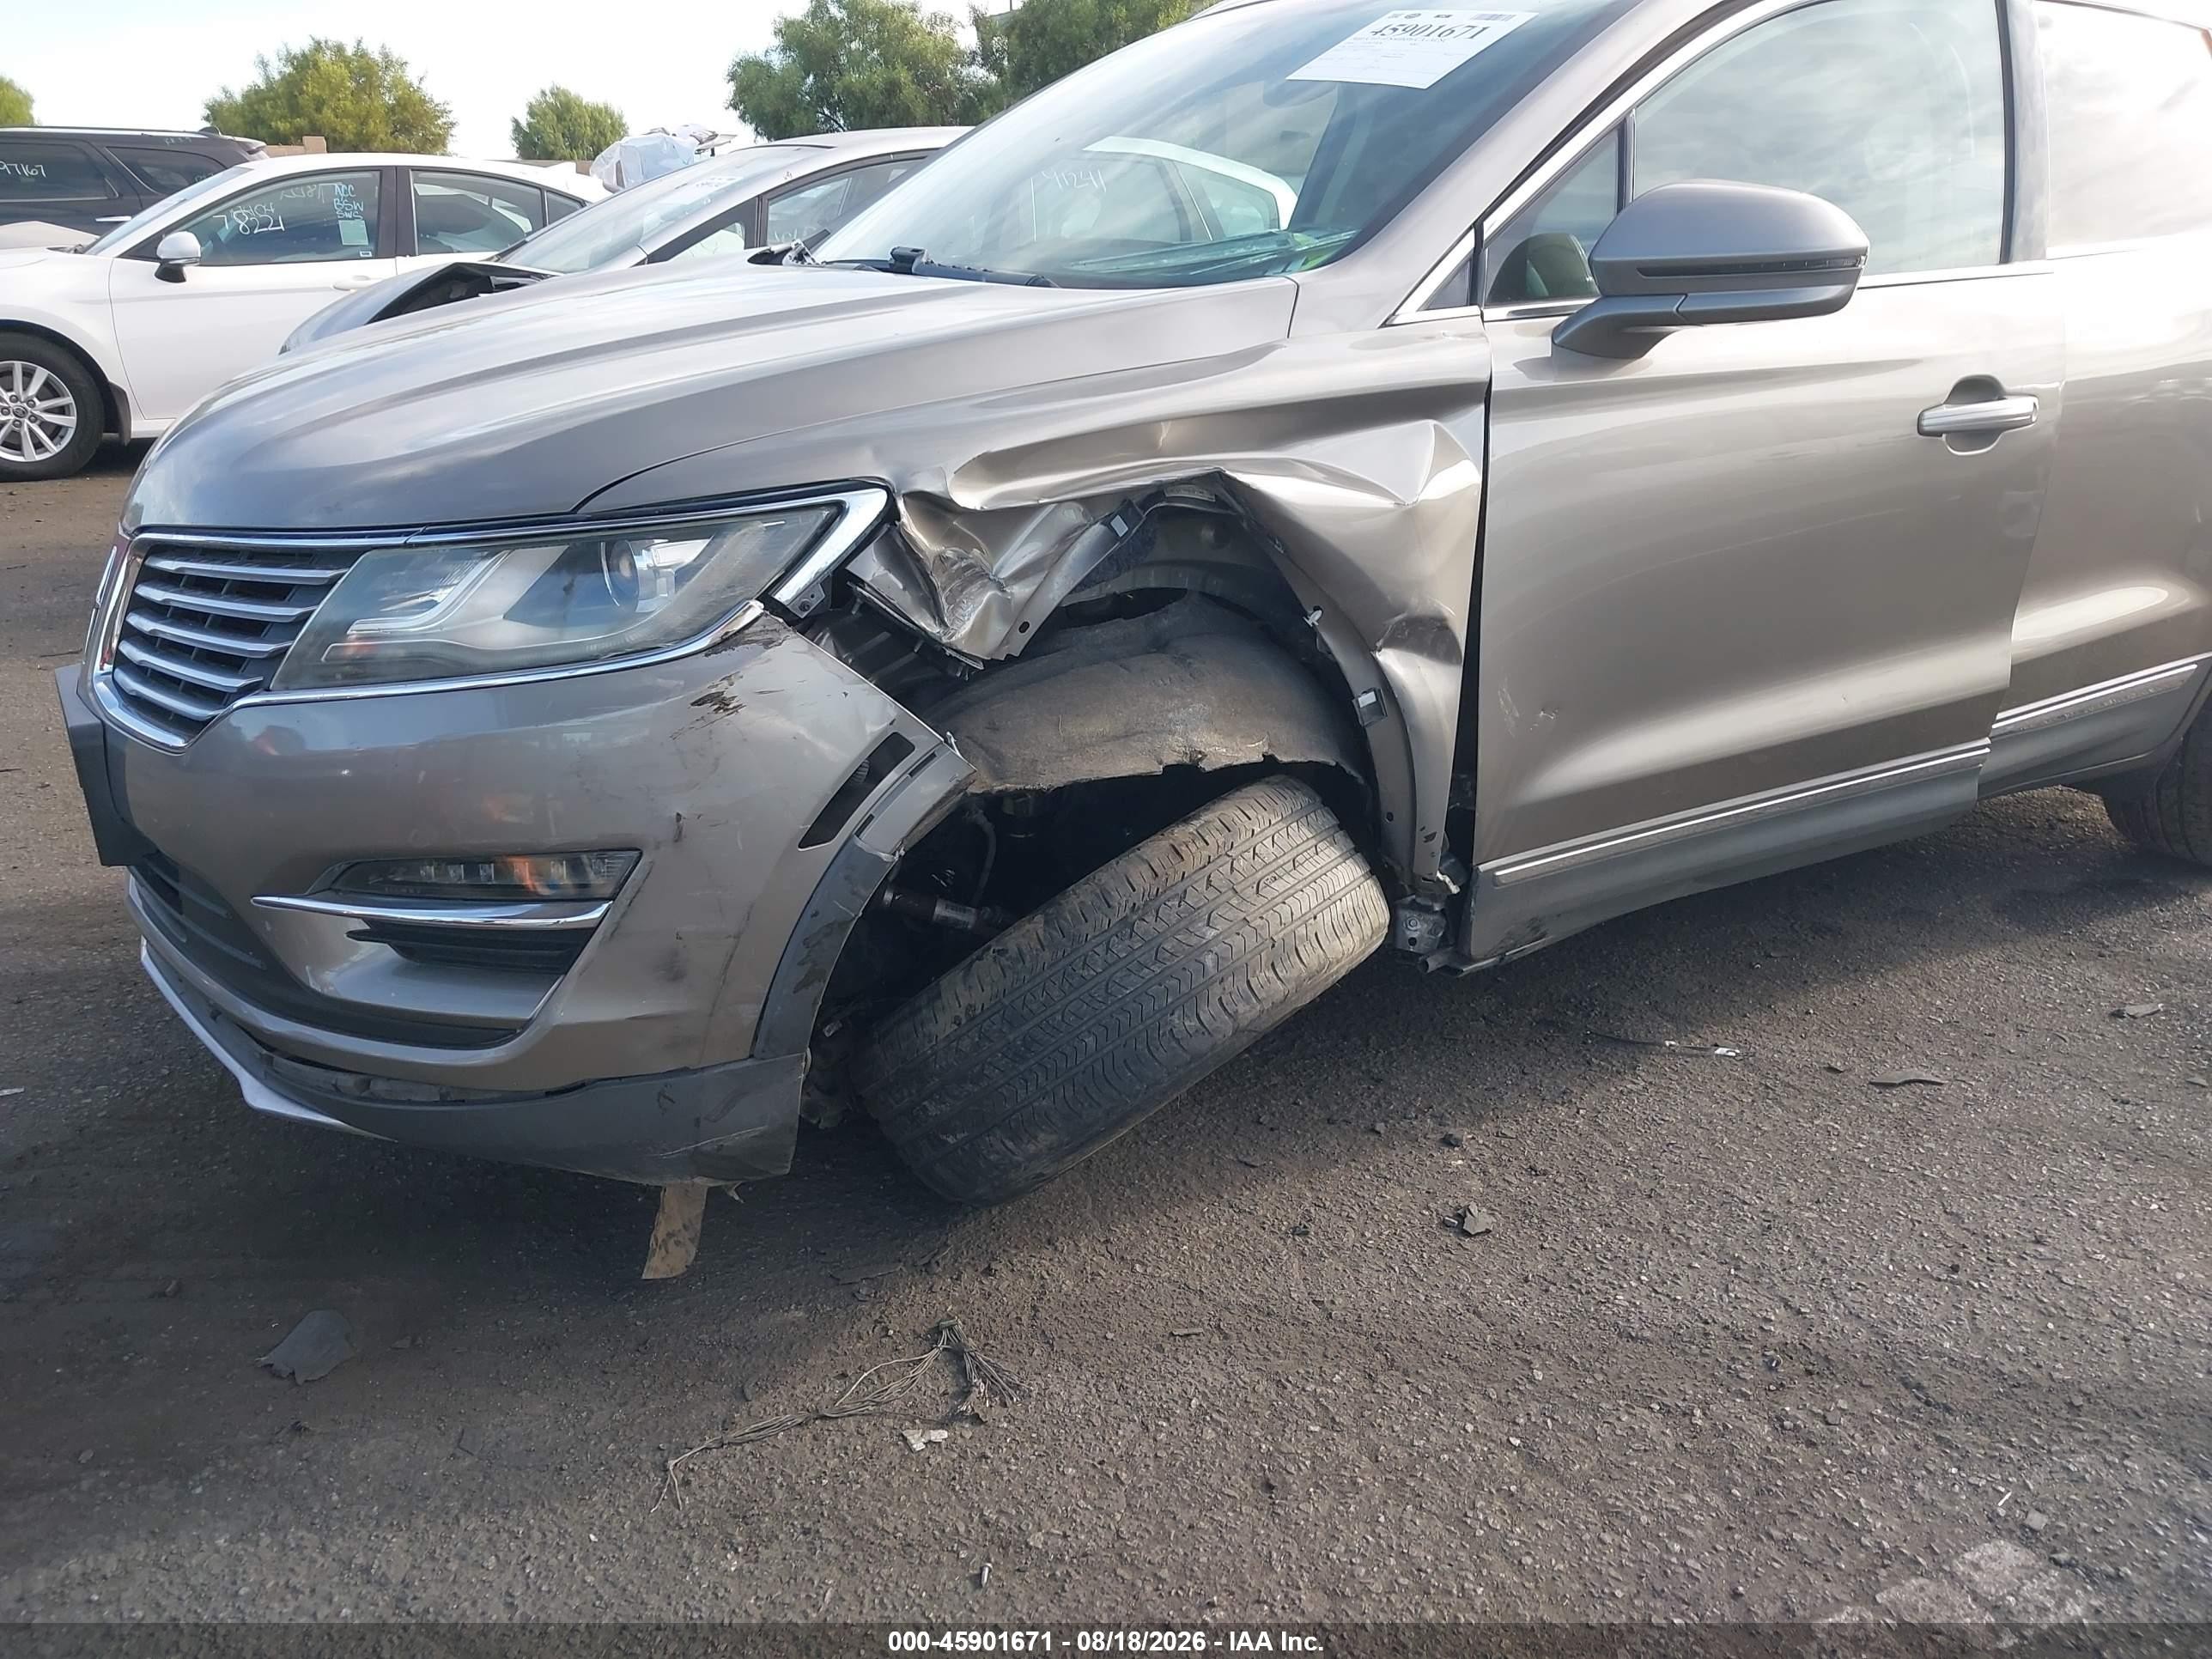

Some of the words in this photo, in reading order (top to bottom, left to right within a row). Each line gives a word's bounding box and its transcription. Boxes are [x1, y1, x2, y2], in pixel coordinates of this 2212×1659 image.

[1370, 23, 1491, 40] 45901671
[334, 184, 357, 201] ACC
[333, 198, 364, 212] BSW
[336, 210, 364, 221] SWS
